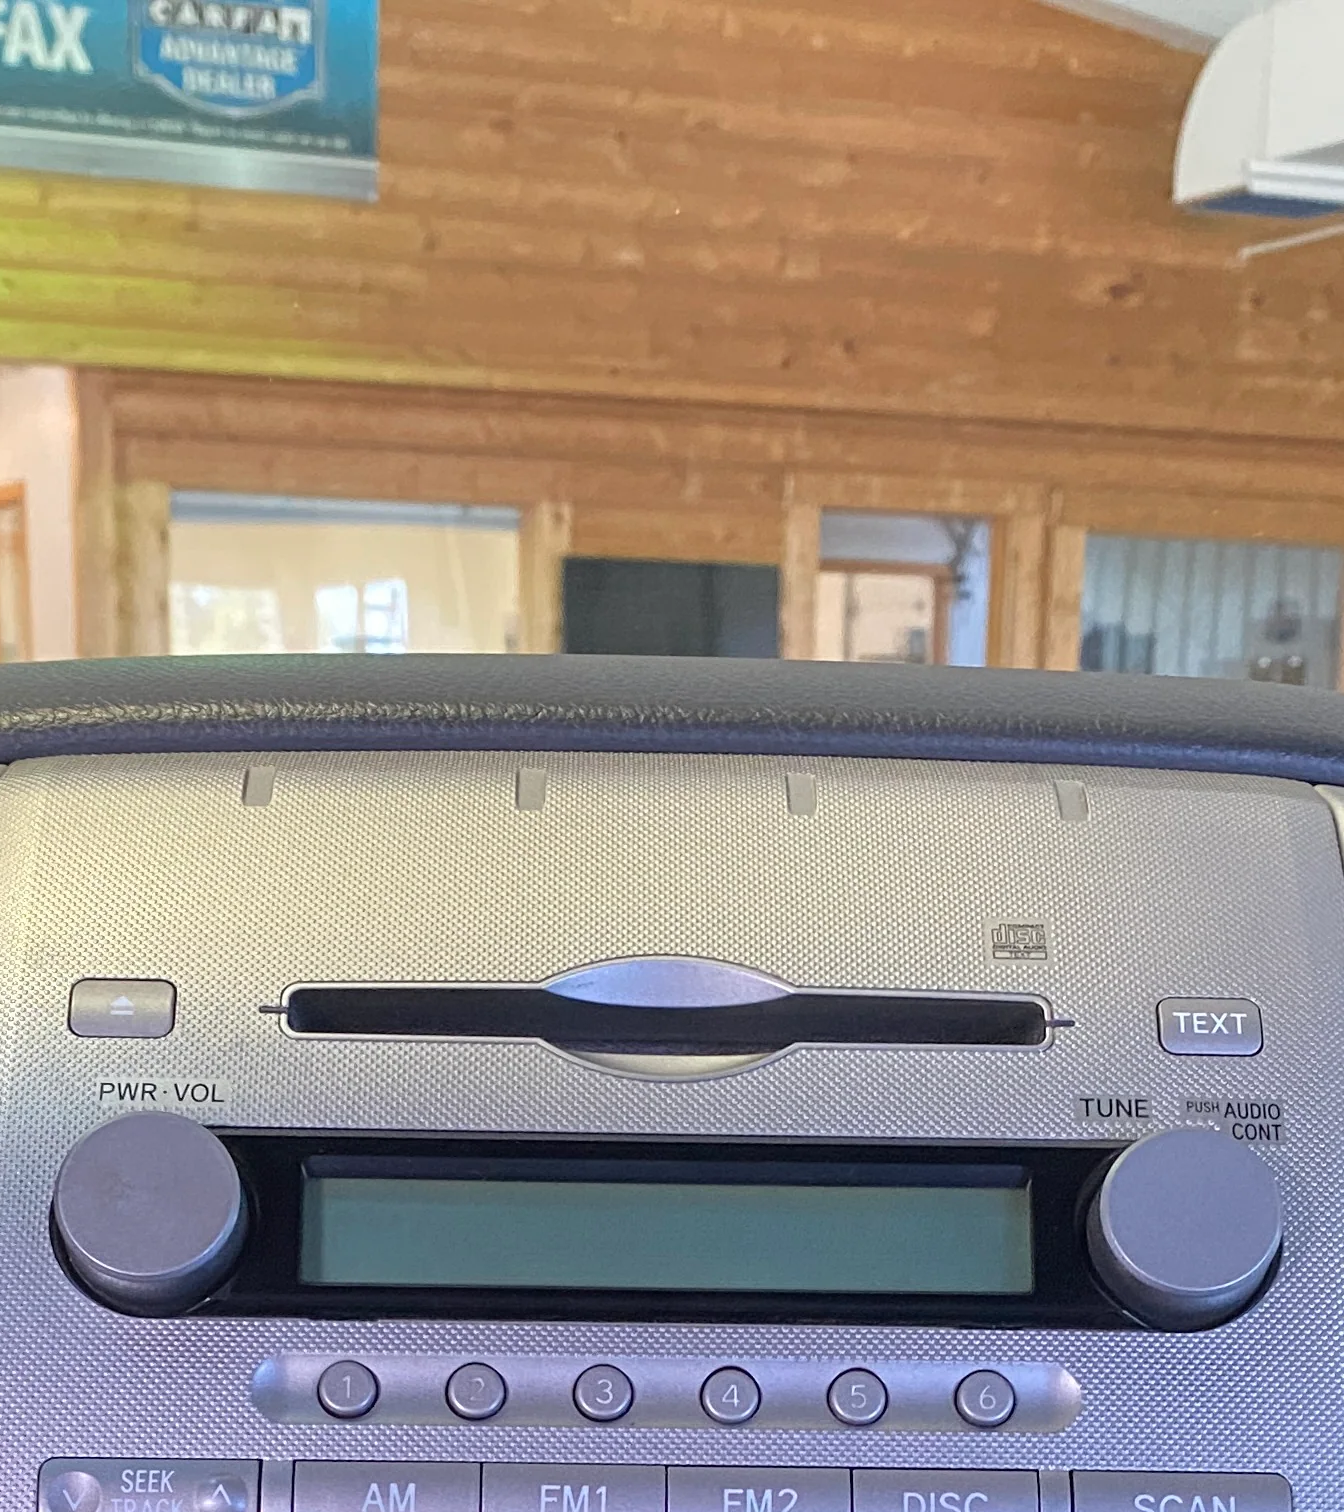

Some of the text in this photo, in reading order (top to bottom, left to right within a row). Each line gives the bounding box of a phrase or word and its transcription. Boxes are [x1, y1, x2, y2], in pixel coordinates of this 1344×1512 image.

[1172, 1011, 1248, 1037] TEXT
[99, 1082, 225, 1103] PWR VOL
[1079, 1098, 1149, 1118] TUNE
[1186, 1101, 1281, 1120] PUSH AUDIO
[1232, 1123, 1282, 1141] CONT
[469, 1377, 485, 1401] 2
[595, 1379, 613, 1404] 3
[722, 1384, 741, 1408] 4
[850, 1384, 867, 1409] 5
[979, 1385, 996, 1410] 6
[120, 1469, 175, 1493] SEEK
